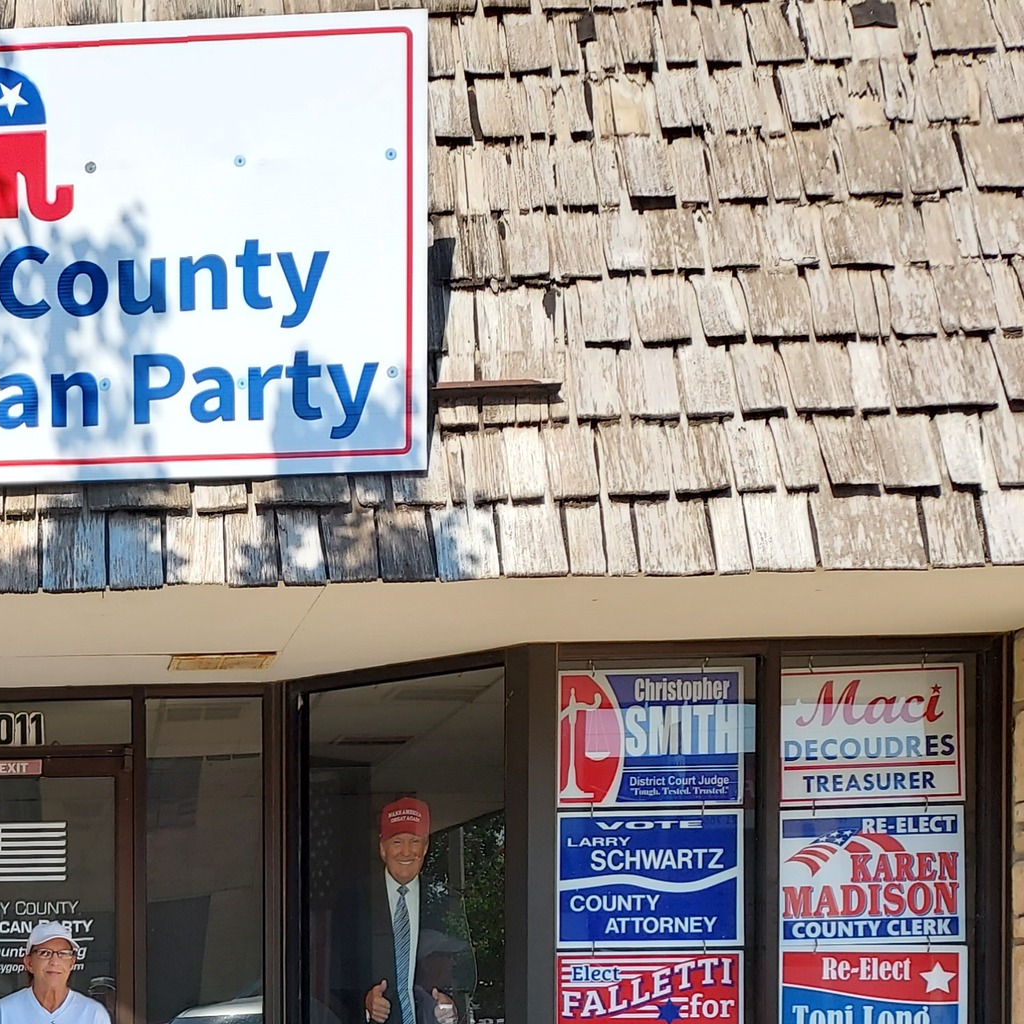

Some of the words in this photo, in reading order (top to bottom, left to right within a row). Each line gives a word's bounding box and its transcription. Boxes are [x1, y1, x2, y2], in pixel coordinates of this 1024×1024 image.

[132, 350, 380, 440] Party
[634, 676, 731, 702] Christopher
[796, 680, 944, 727] Maci
[626, 704, 738, 756] SMITH
[783, 734, 955, 762] DECOUDRES
[629, 776, 666, 786] District
[669, 775, 697, 786] Court
[698, 775, 730, 787] Judge
[803, 771, 936, 793] TREASURER
[595, 820, 703, 830] VOTE
[862, 816, 956, 834] RE-ELECT
[567, 837, 631, 847] LARRY
[590, 848, 724, 871] SCHWARTZ
[850, 852, 959, 883] KAREN
[15, 900, 79, 915] COUNTY
[570, 894, 661, 912] COUNTY
[783, 882, 959, 919] MADISON
[604, 916, 718, 934] ATTORNEY
[791, 920, 882, 938] COUNTY
[886, 918, 952, 936] CLERK
[571, 965, 620, 982] Elect
[821, 957, 912, 981] Re-Elect
[561, 957, 734, 1019] FALLETTI
[689, 993, 735, 1018] for
